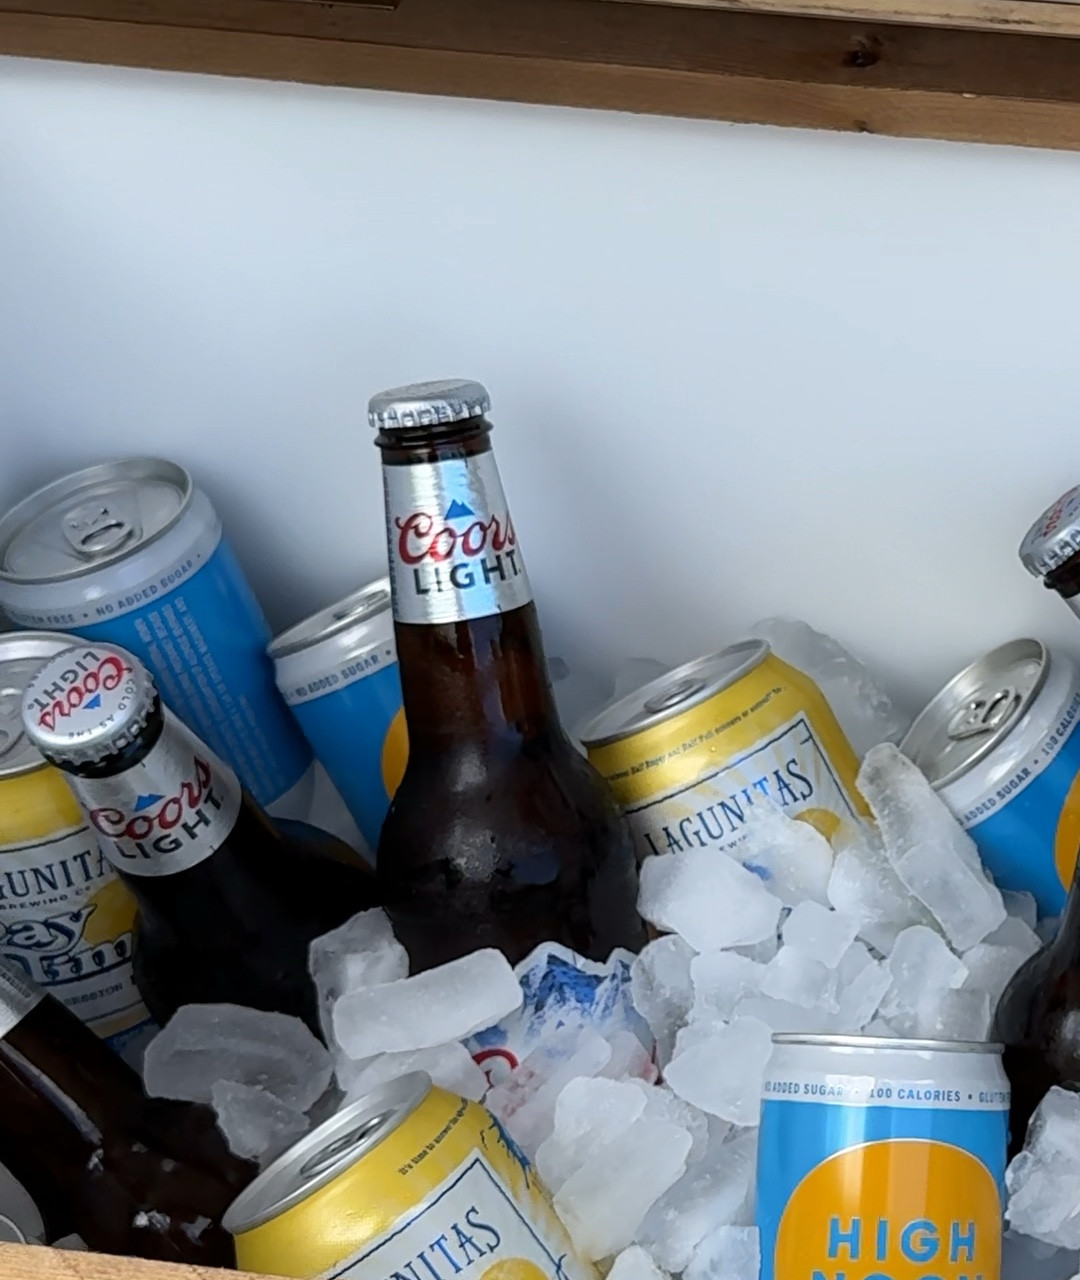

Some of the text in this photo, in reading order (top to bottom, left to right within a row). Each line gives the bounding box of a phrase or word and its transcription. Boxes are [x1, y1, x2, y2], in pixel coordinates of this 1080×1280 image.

[395, 510, 516, 565] Coors
[118, 585, 159, 609] ADDED
[413, 550, 519, 595] LIGHT
[33, 650, 100, 713] LIGHT
[38, 656, 134, 732] Coors
[340, 654, 380, 680] SUGAR
[81, 756, 212, 840] Coors
[964, 799, 997, 823] ADDED
[995, 767, 1032, 800] SUGAR
[1041, 735, 1059, 757] 100
[114, 788, 217, 859] LIGHT
[772, 1081, 800, 1095] ADDED
[804, 1083, 844, 1097] SUGAR
[870, 1087, 893, 1099] 100
[897, 1088, 962, 1103] CALORIES
[828, 1216, 976, 1263] HIGH
